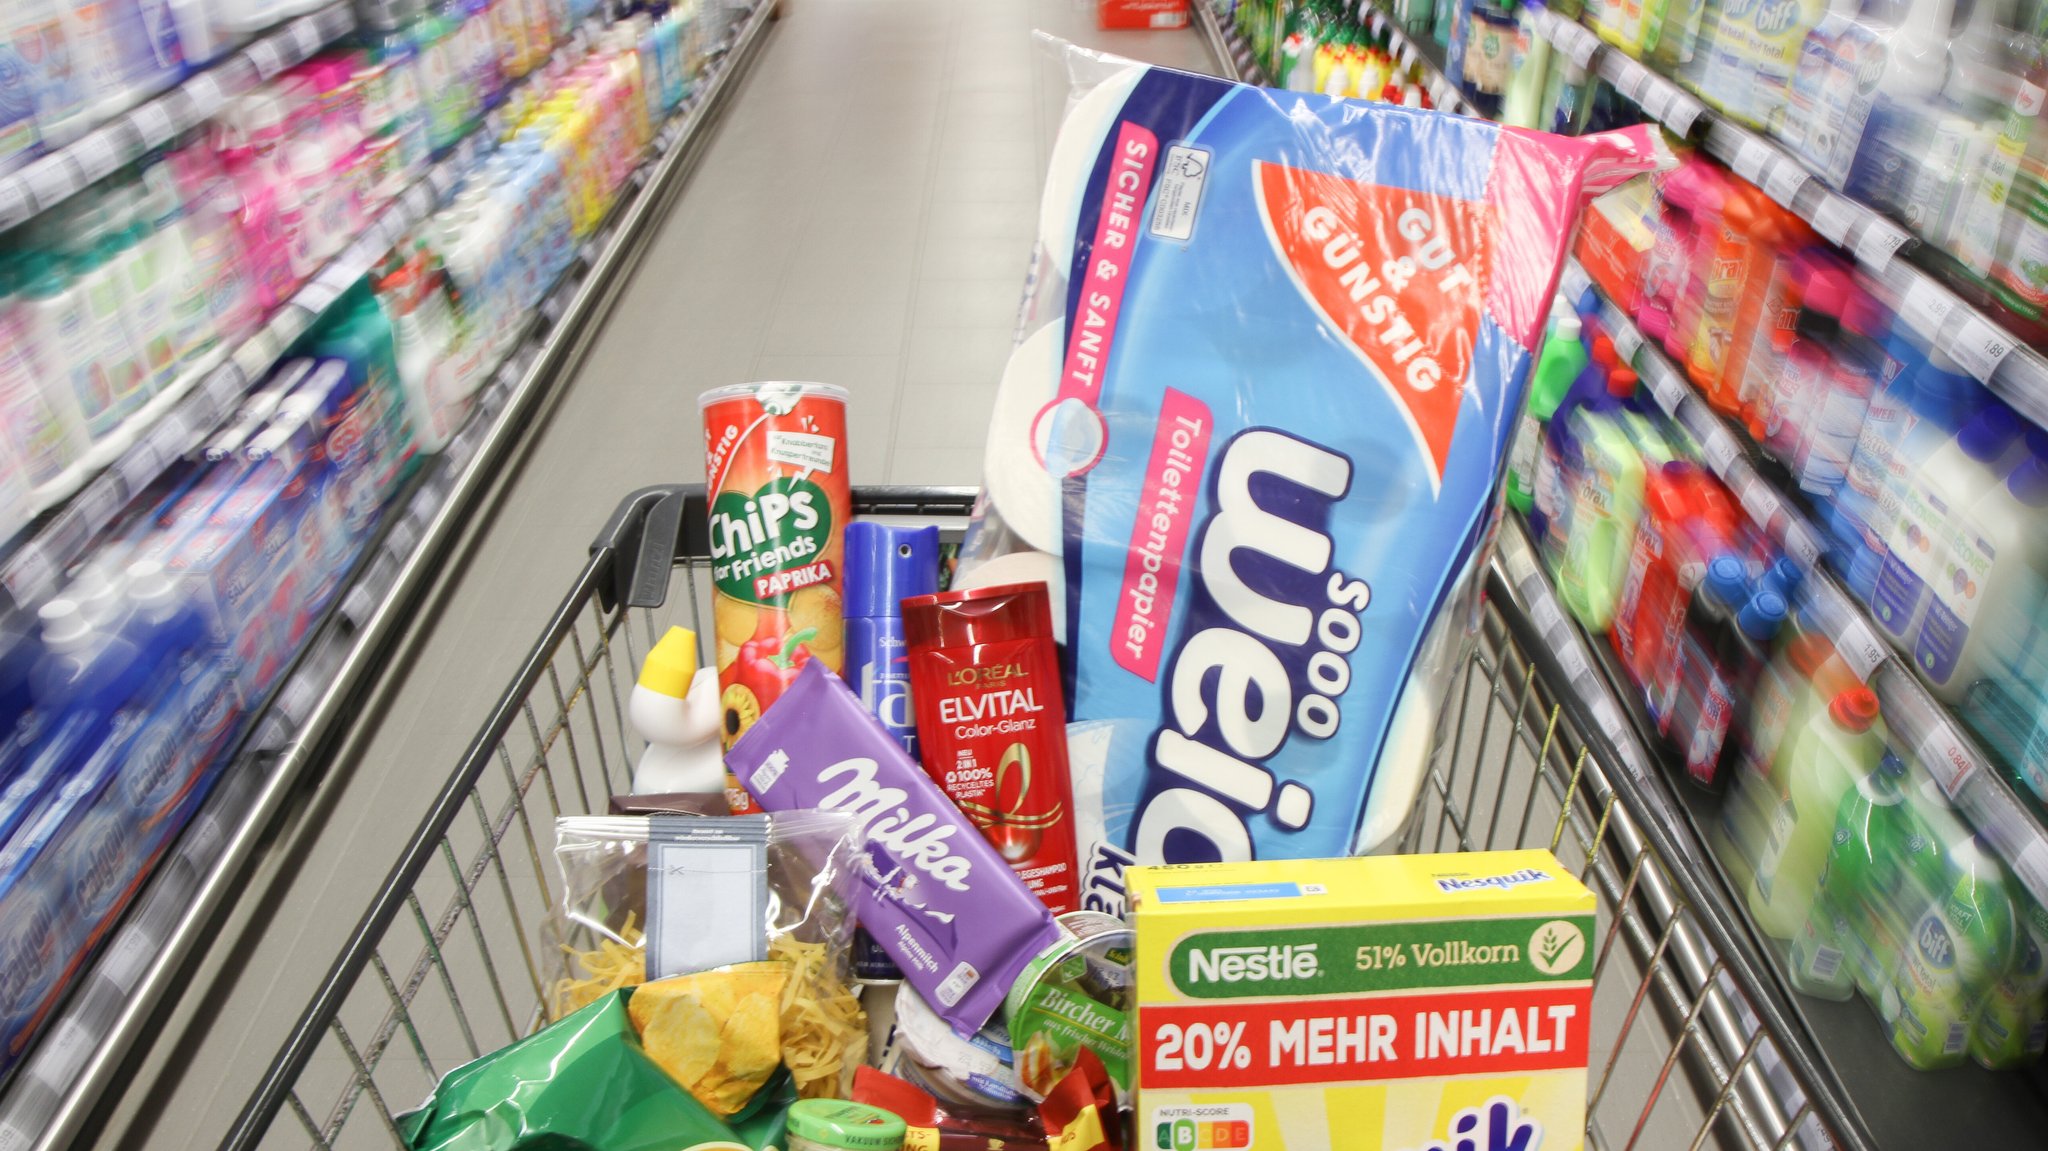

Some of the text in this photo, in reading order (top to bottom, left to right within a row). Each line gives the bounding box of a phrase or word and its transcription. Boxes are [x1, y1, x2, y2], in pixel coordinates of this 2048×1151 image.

[1072, 139, 1148, 387] SICHER & SANFT
[1397, 208, 1474, 293] GUT
[1381, 256, 1417, 293] &
[1303, 206, 1441, 392] GÜNSTIG
[1984, 339, 2004, 358] 1,89
[1125, 414, 1203, 660] Toilettenpapier
[731, 536, 817, 582] Friends
[756, 563, 832, 597] PAPRIKA
[1863, 643, 1881, 664] 1,95
[948, 662, 1030, 687] L'ORÉAL
[939, 687, 1044, 724] ELVITAL
[954, 718, 1037, 740] Color-Glanz
[956, 749, 973, 757] NEU
[947, 779, 995, 792] RECYCELTES
[956, 767, 993, 783] 100%
[817, 757, 973, 891] Milka
[1438, 868, 1551, 891] Nesquik
[896, 924, 939, 973] Alpenmilch
[1920, 921, 1951, 964] biff
[1188, 941, 1520, 983] Nestlé 51% Vollkorn
[1040, 988, 1116, 1033] Bircher
[1155, 1005, 1577, 1072] 20% MEHR INHALT
[1159, 1107, 1230, 1118] NUTRI-SCORE
[845, 1135, 881, 1146] VAKUUM
